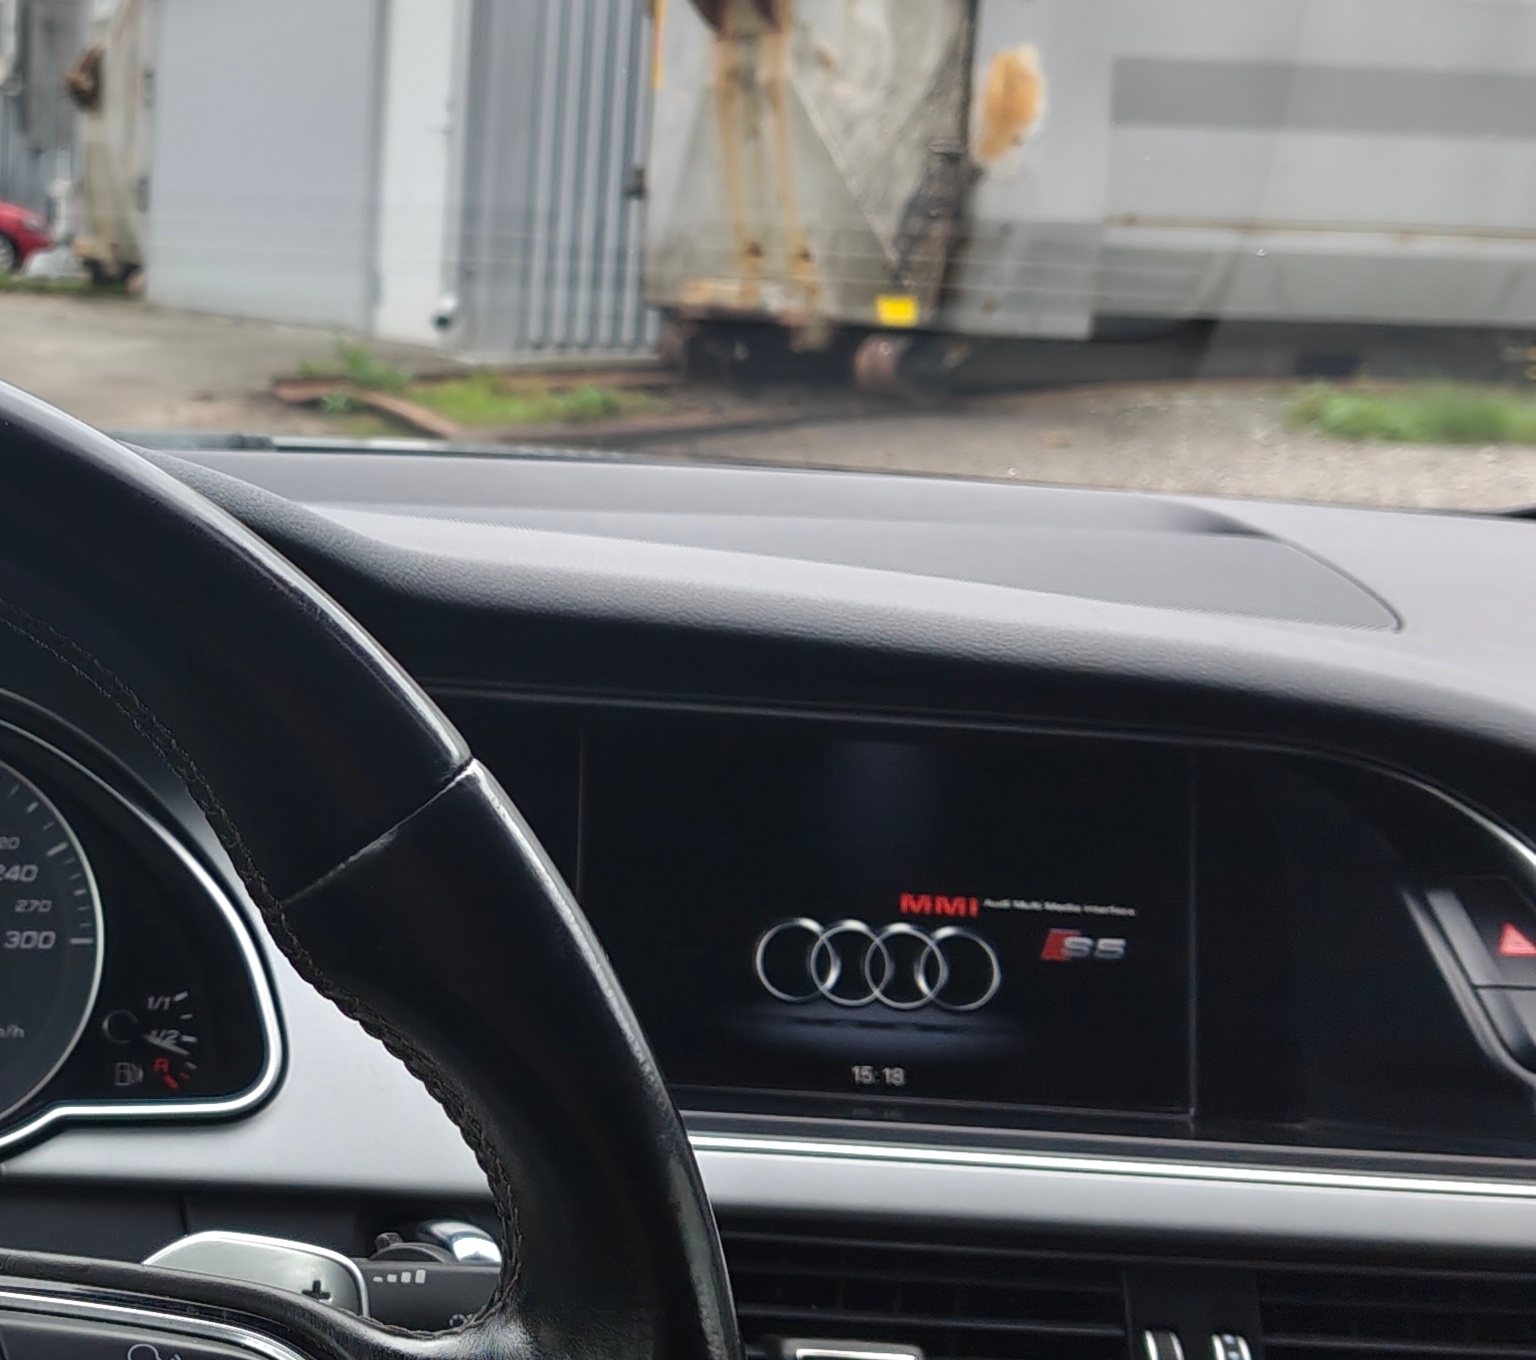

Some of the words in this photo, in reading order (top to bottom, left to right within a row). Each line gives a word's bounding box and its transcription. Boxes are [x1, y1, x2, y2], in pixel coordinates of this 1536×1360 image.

[15, 899, 52, 913] 270
[899, 893, 978, 917] MMI
[4, 931, 56, 950] 300
